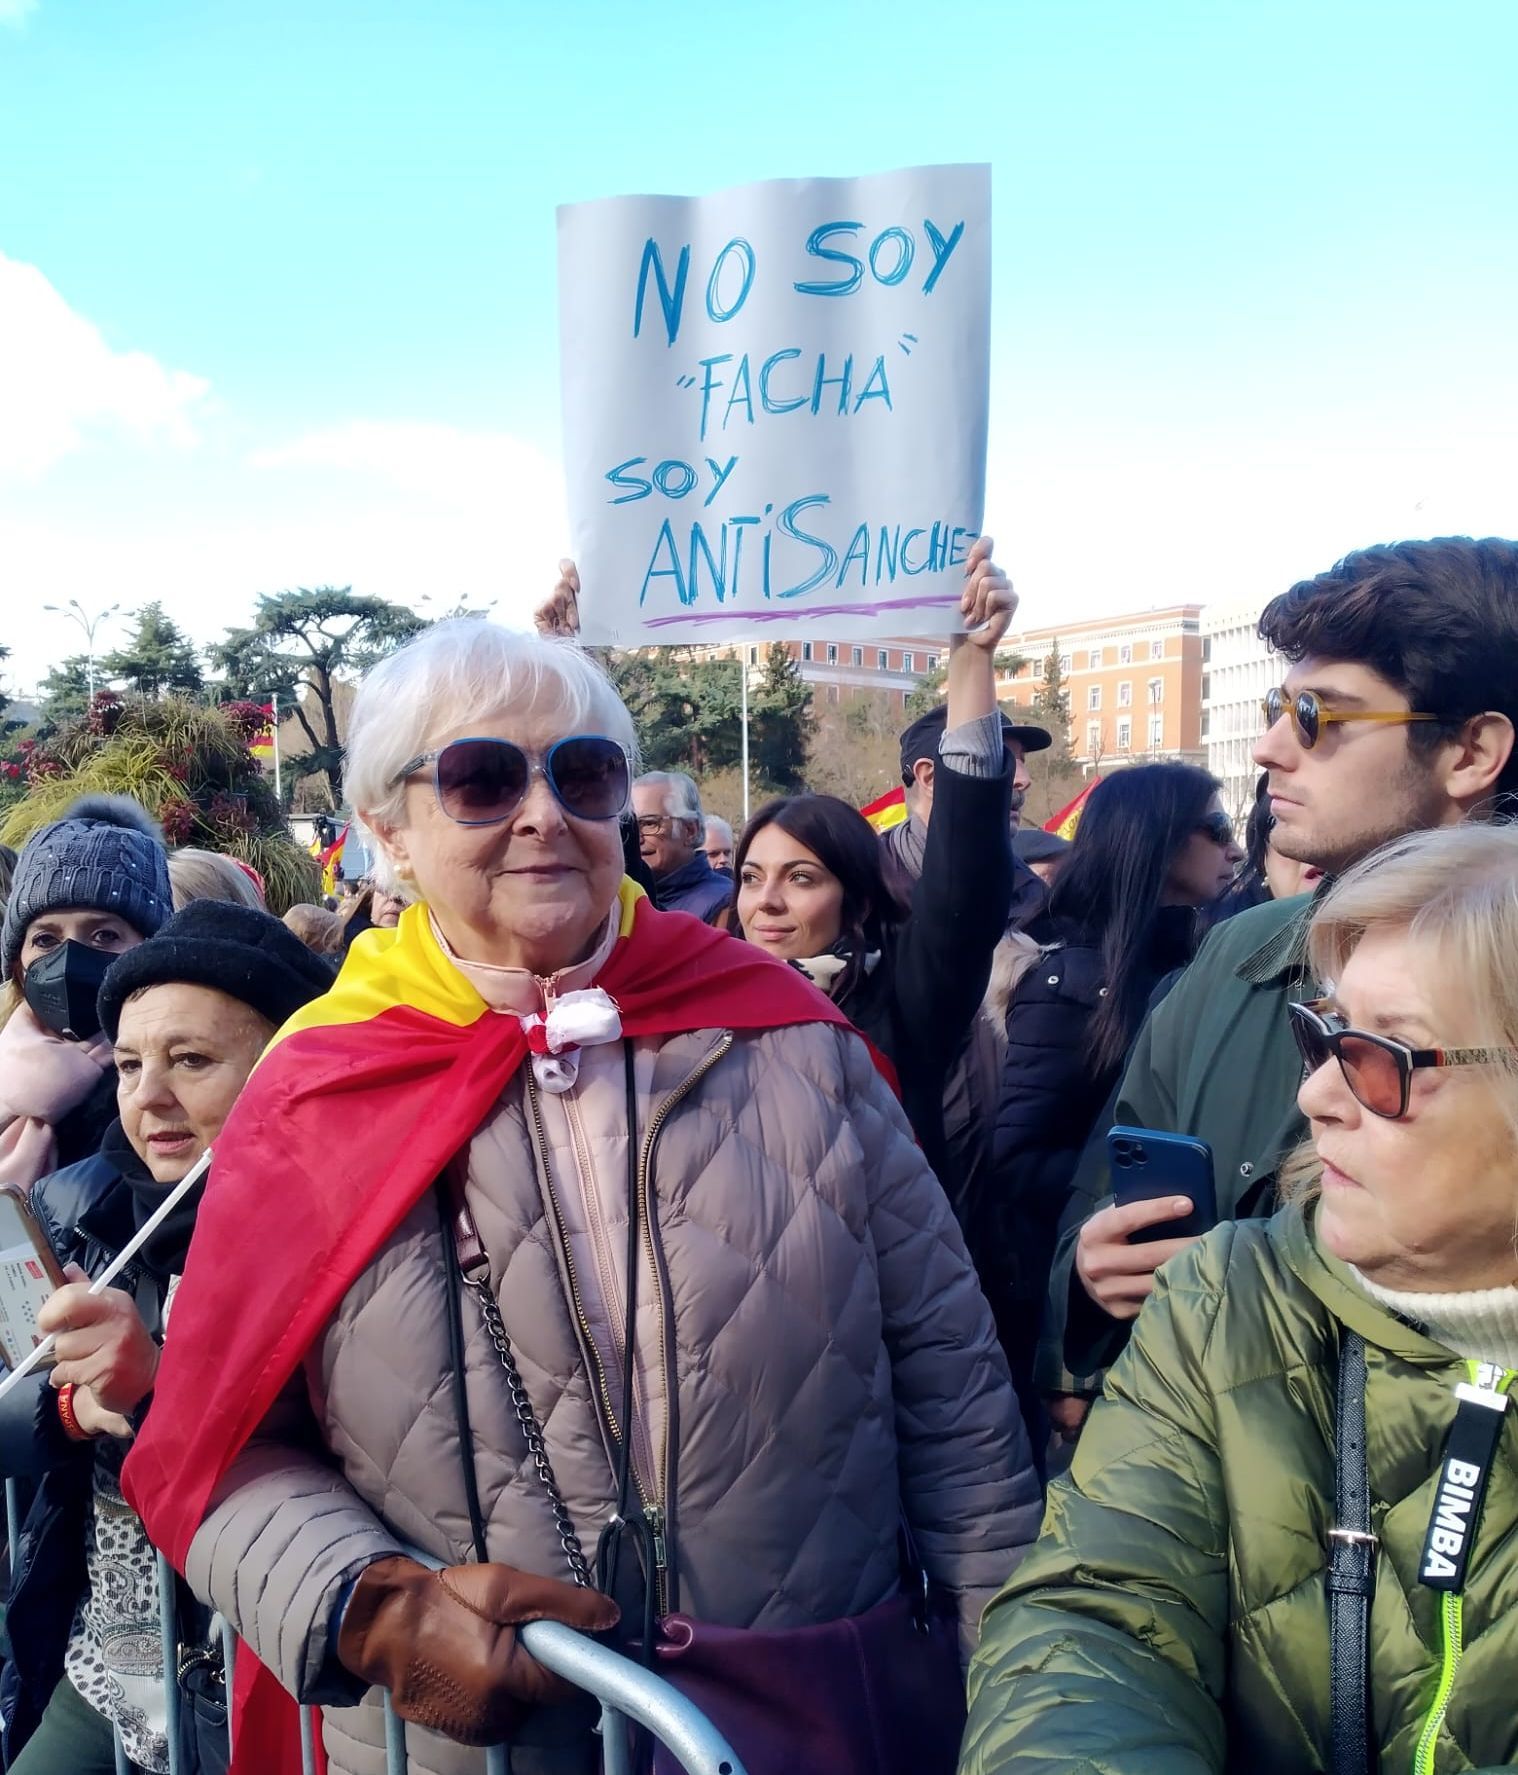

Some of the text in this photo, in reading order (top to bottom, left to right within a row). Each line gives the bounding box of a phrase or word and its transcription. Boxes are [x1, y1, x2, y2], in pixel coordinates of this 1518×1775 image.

[633, 218, 966, 348] NO SOY
[604, 455, 739, 507] SOY
[1423, 1458, 1481, 1577] BIMBA
